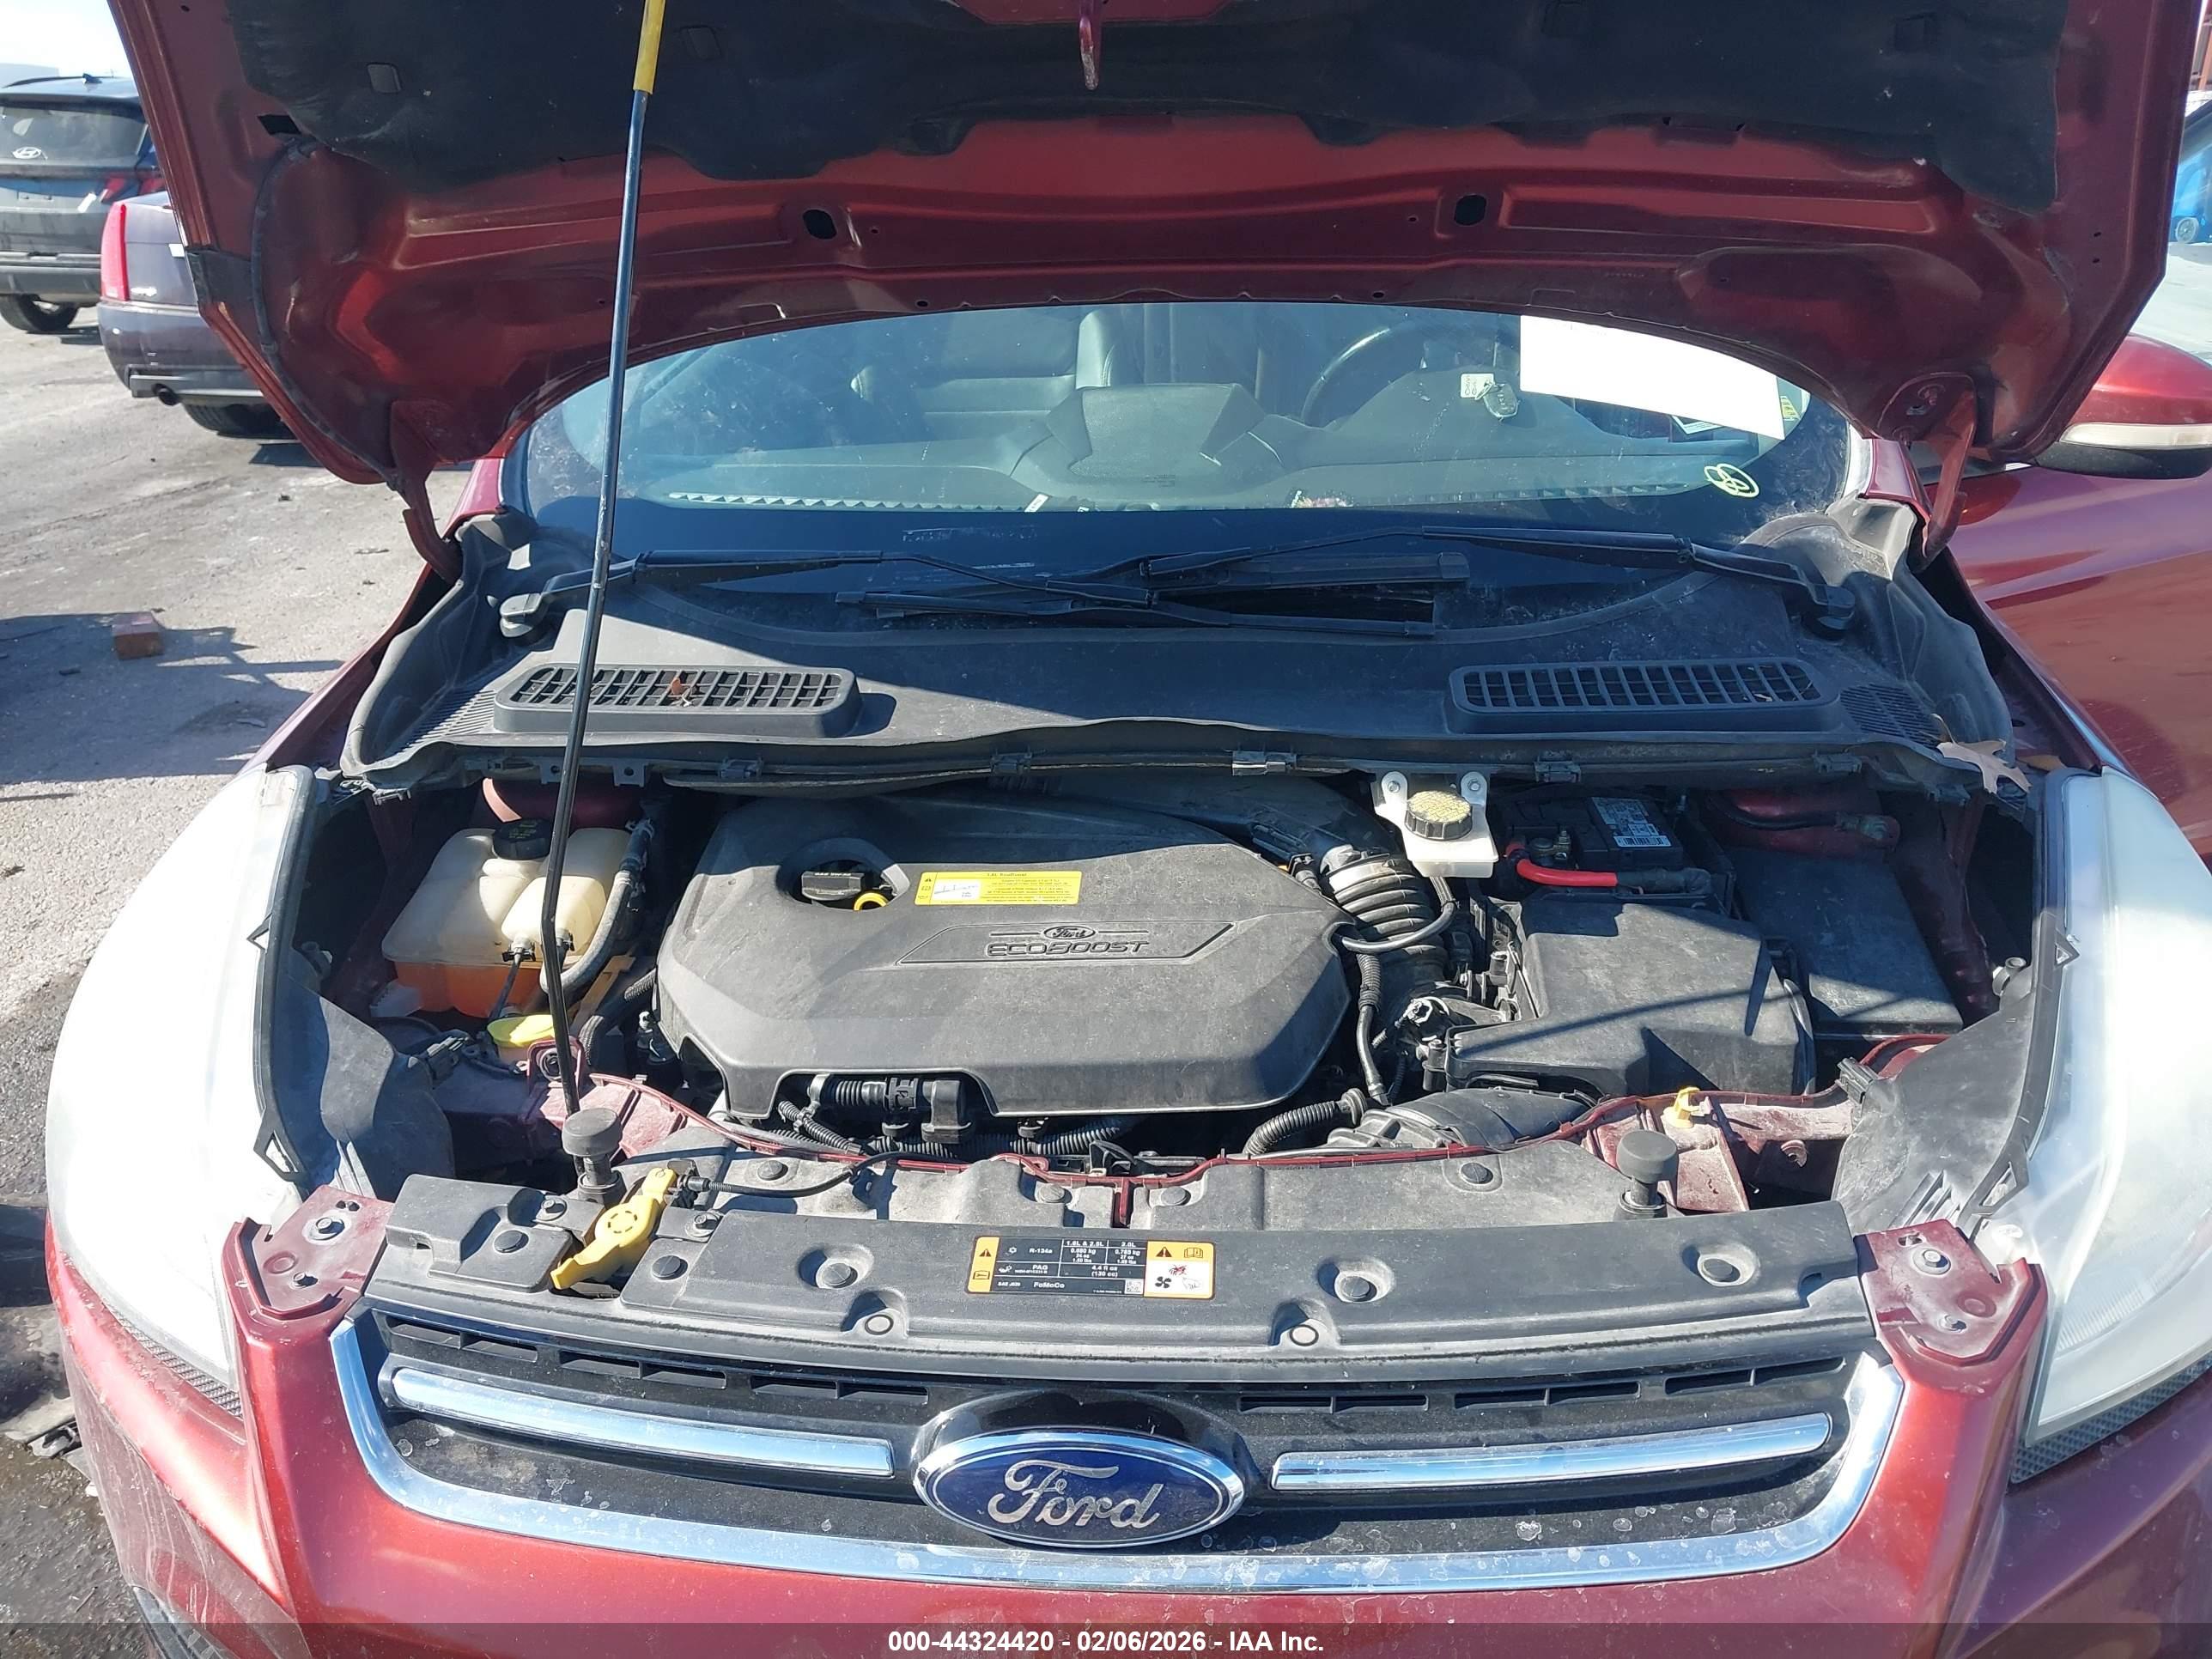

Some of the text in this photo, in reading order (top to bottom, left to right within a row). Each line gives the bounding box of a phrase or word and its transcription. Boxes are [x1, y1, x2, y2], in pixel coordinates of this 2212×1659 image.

[1052, 927, 1087, 938] Ford
[987, 939, 1149, 957] ECOBOOST
[987, 1459, 1164, 1529] Ford
